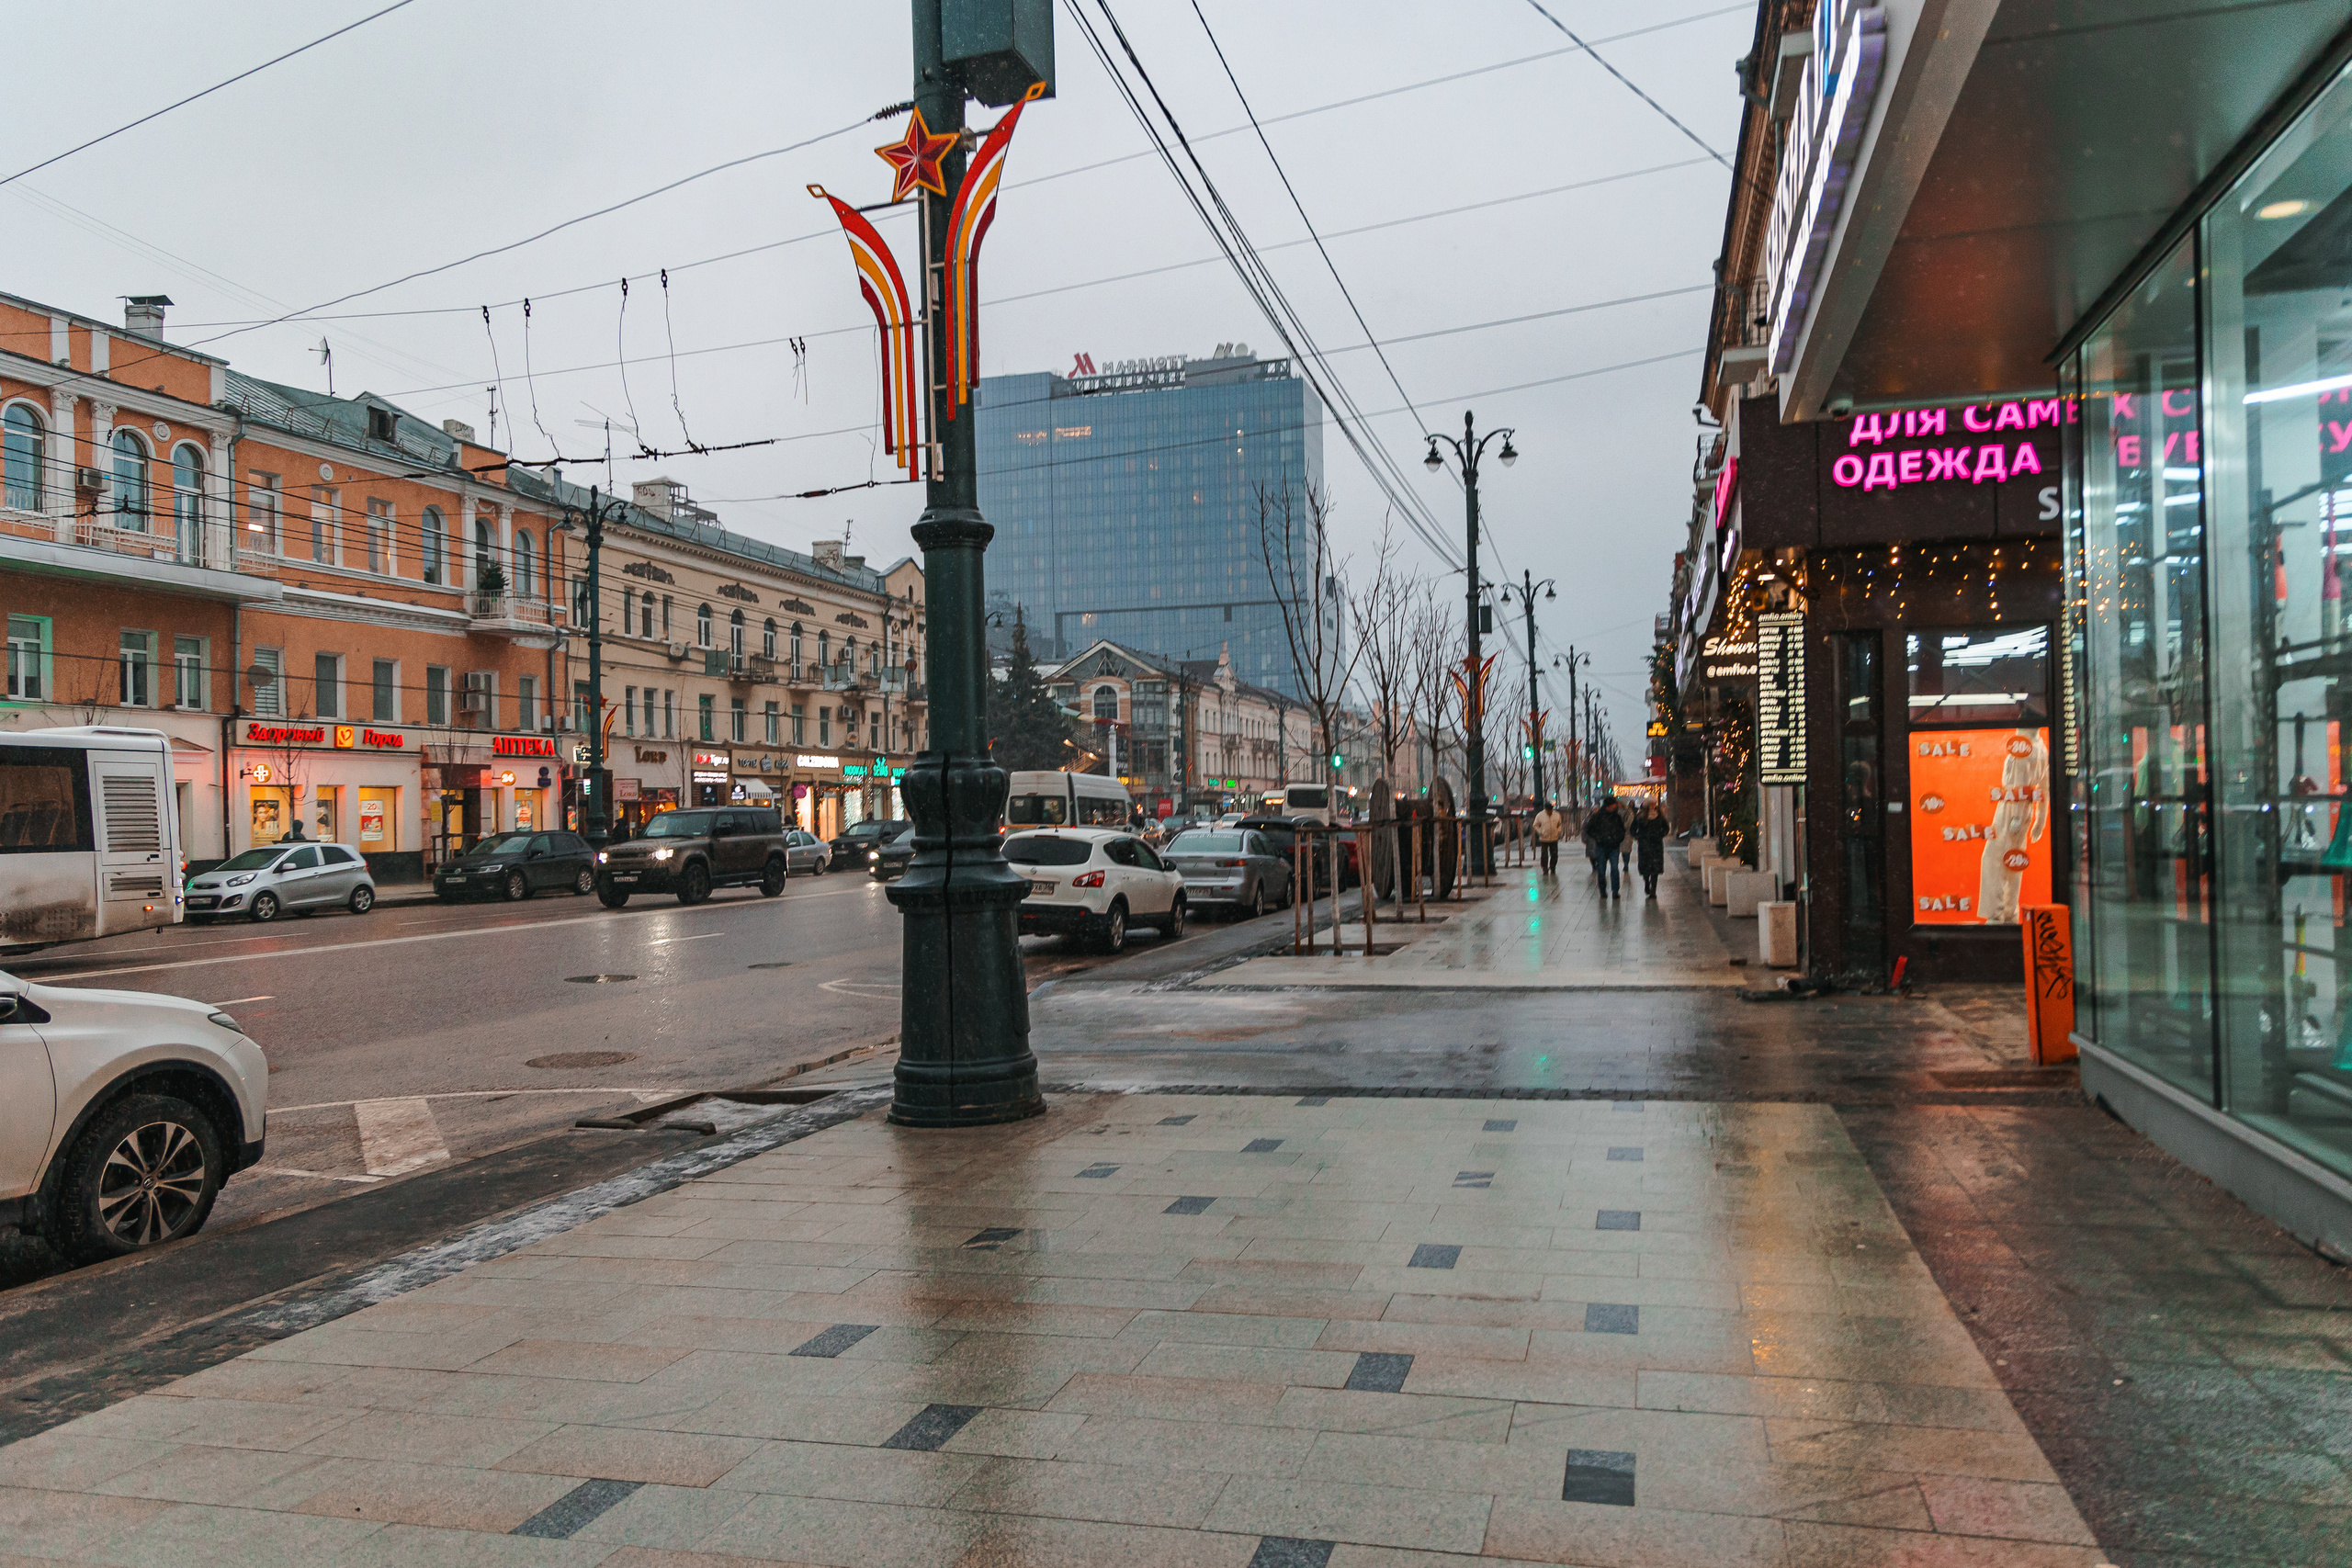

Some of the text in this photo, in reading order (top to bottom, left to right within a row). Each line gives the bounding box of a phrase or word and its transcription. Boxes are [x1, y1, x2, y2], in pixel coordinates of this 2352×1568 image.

[1102, 354, 1188, 374] MARRIOTT
[1848, 407, 1946, 447] ДЛЯ
[1832, 442, 2041, 491] ОДЕЖДА
[247, 722, 403, 749] Здоровый Город
[492, 736, 555, 756] АПТЕКА
[1919, 741, 1970, 757] SALE
[1990, 787, 2043, 803] SALE
[1942, 825, 1995, 841] SALE
[1918, 895, 1970, 911] SALE
